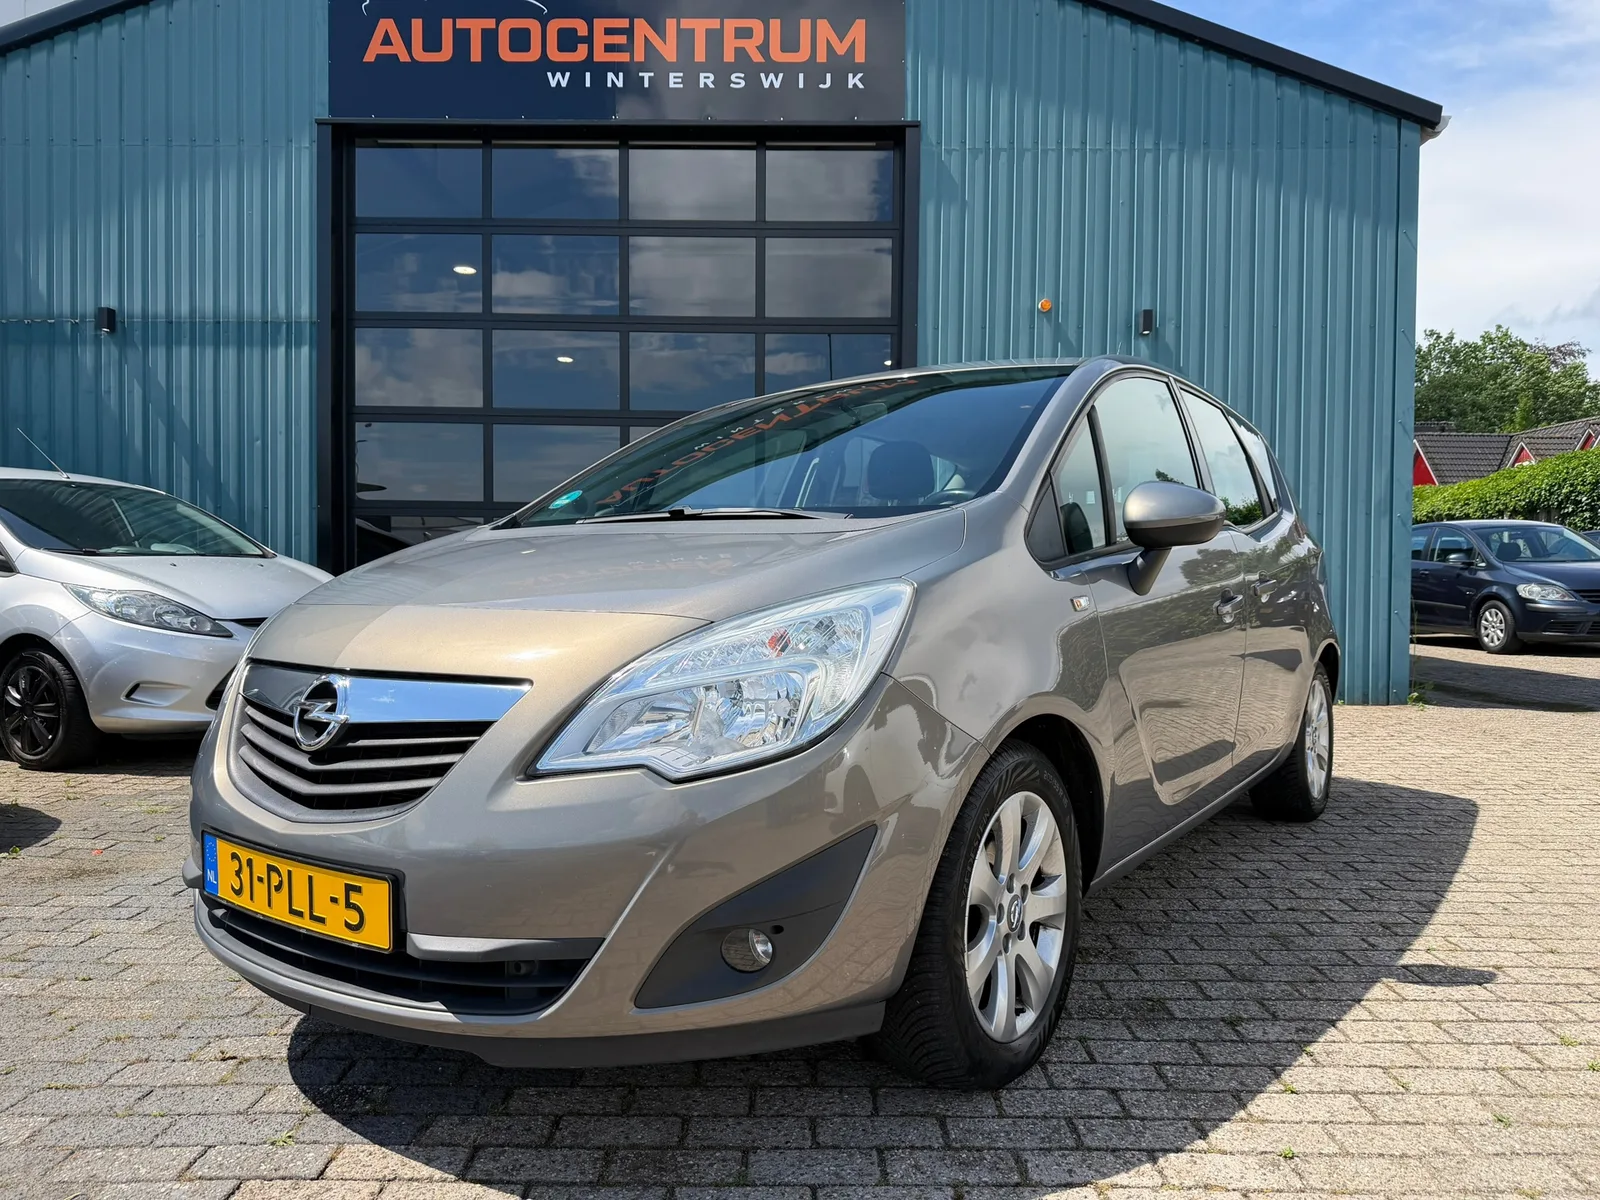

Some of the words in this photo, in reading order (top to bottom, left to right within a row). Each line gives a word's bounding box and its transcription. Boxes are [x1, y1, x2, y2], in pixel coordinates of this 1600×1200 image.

[362, 18, 866, 63] AUTOCENTRUM
[546, 71, 865, 89] WINTERSWIJK
[207, 868, 218, 885] NL
[230, 851, 366, 933] 31-PLL-5
